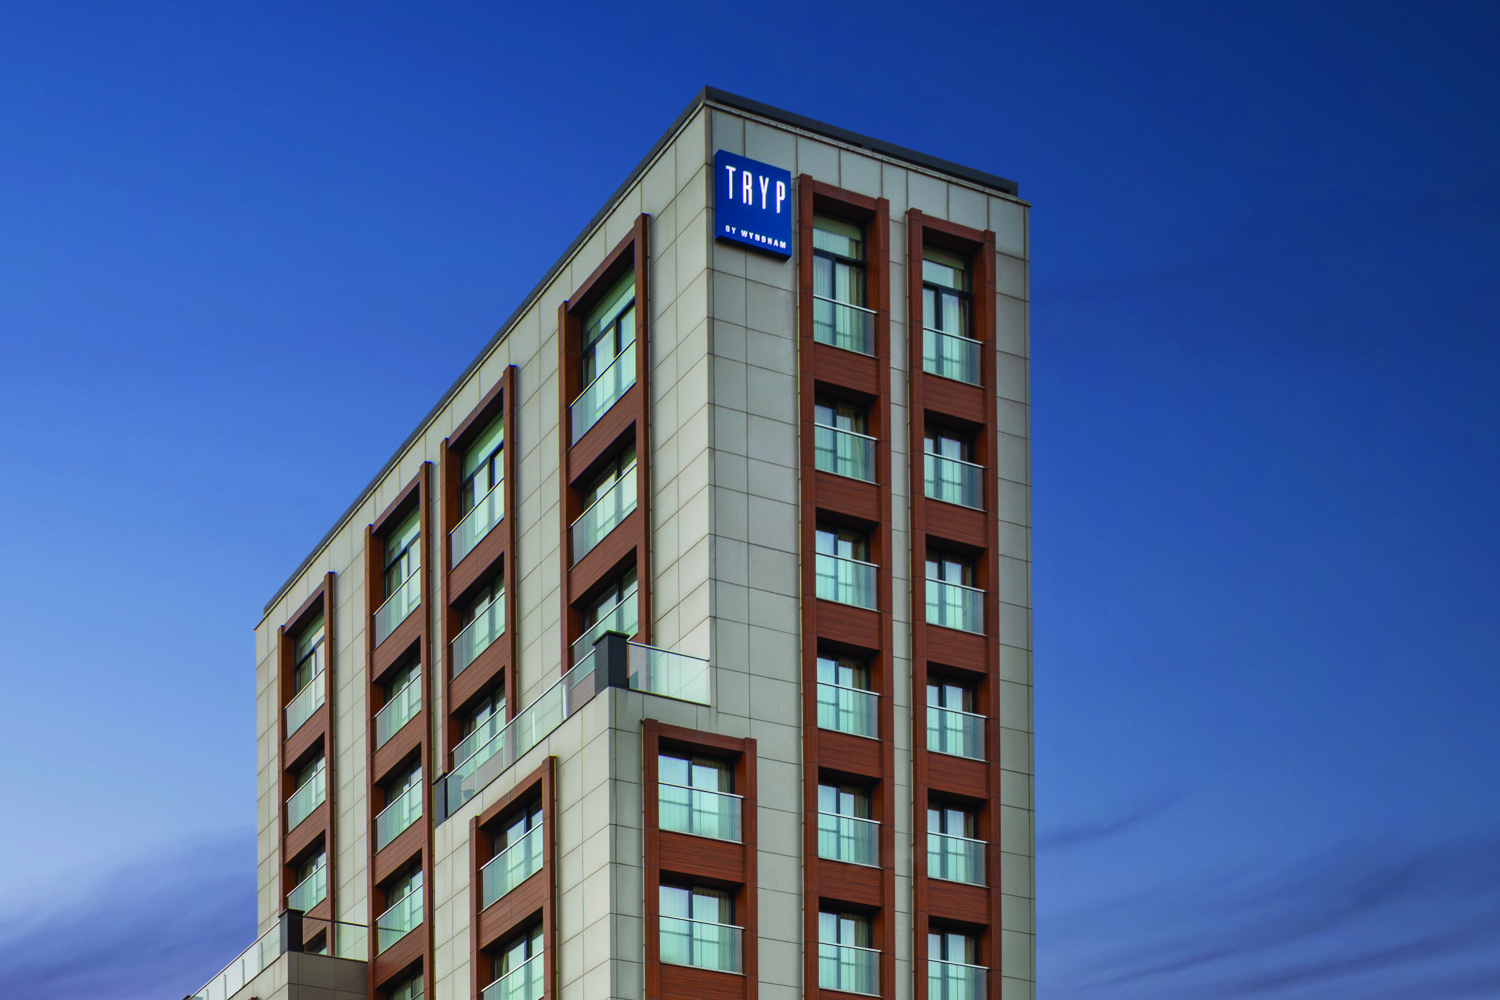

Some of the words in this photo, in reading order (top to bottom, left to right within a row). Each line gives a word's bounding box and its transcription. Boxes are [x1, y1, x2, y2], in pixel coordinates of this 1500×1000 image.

[725, 165, 786, 214] TRYP
[725, 225, 737, 235] BY
[740, 229, 787, 249] WYNDHAM
